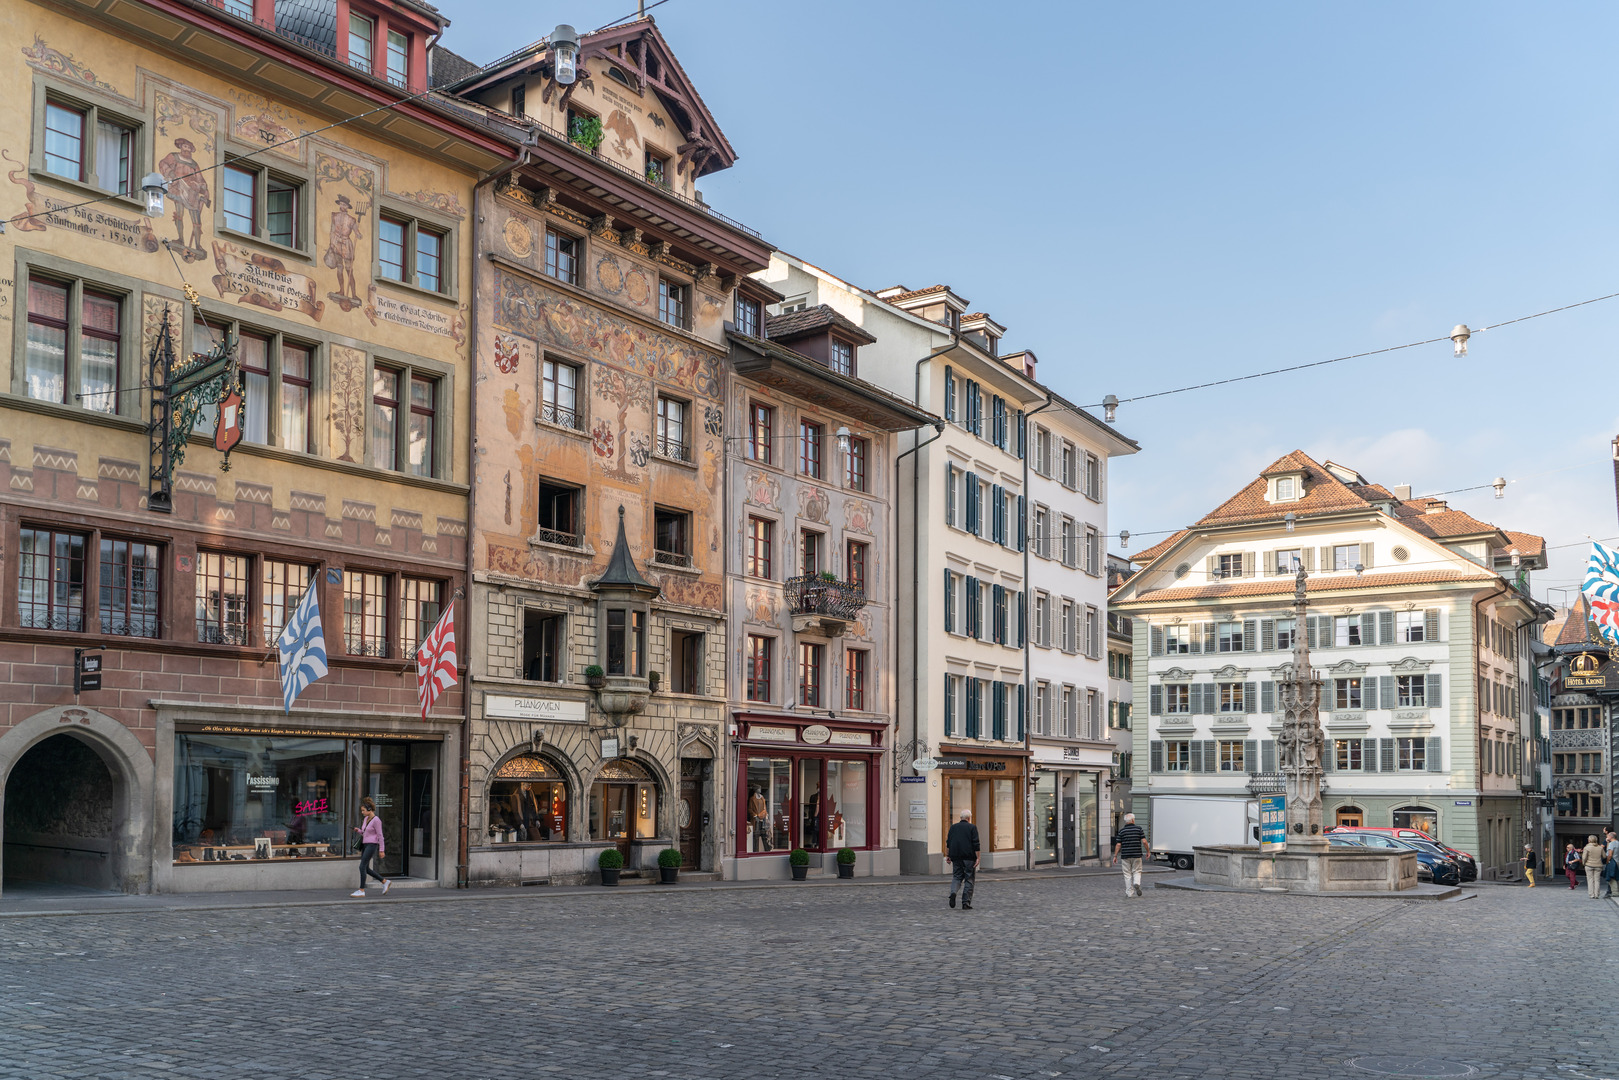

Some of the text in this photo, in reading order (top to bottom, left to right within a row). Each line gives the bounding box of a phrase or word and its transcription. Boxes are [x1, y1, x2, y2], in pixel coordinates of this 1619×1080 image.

[227, 279, 299, 308] 1529 1873
[295, 798, 329, 814] SALE
